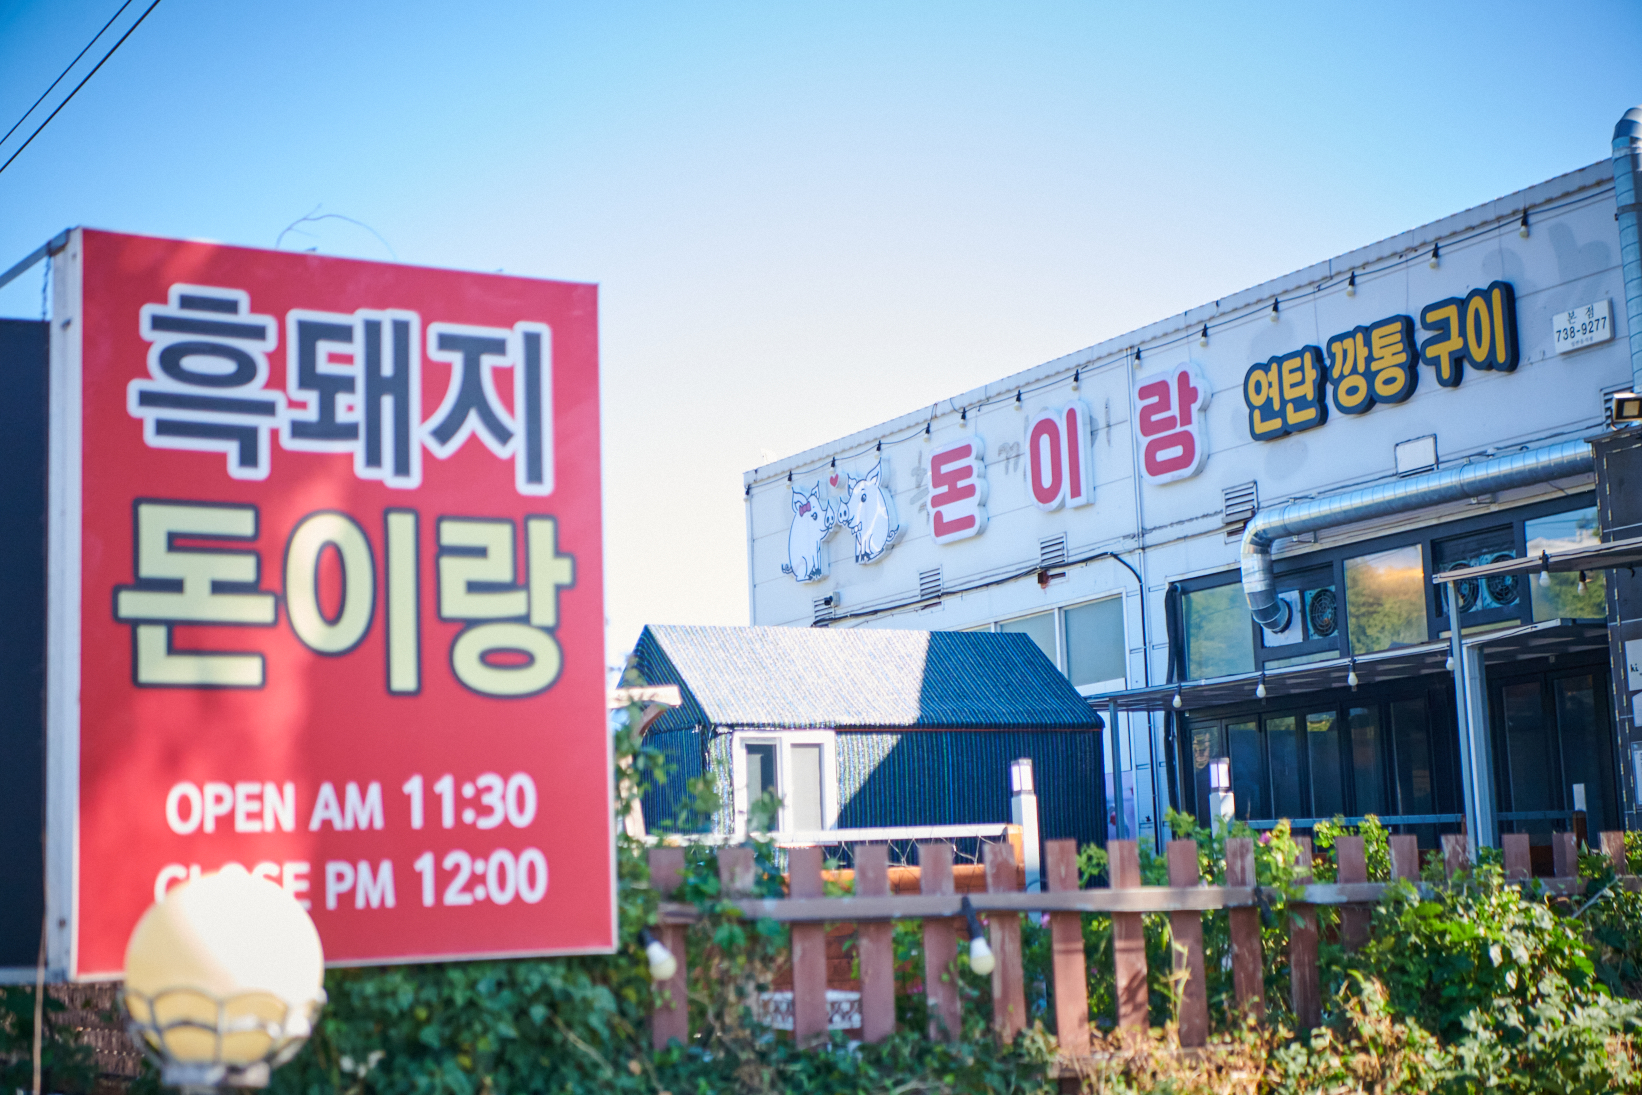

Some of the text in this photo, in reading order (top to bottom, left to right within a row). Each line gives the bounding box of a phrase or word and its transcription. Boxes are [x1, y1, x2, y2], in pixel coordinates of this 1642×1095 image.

[1246, 285, 1508, 437] 연탄 깡통 구이
[1556, 316, 1607, 342] 738-9277
[130, 285, 551, 494] 흑돼지
[114, 498, 575, 698] 돈이랑
[165, 772, 538, 836] OPEN AM 11:30
[325, 859, 396, 910] PM
[414, 847, 549, 907] 12:00
